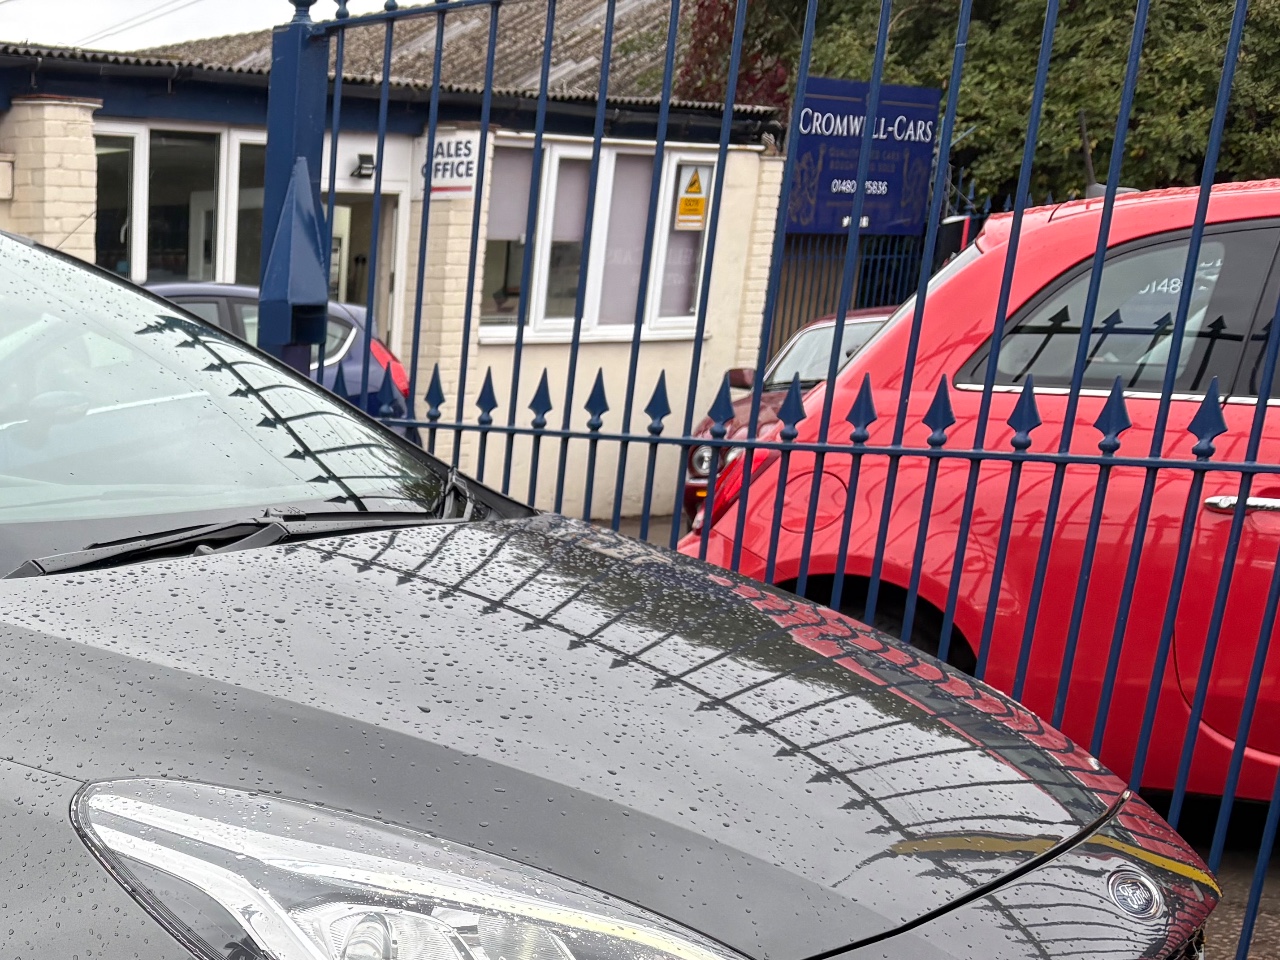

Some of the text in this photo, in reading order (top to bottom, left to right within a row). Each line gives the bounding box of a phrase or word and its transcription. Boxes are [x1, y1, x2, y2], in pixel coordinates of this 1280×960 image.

[799, 108, 933, 143] CROMWLL-CARS
[429, 140, 472, 158] ALES
[865, 181, 888, 195] 5836
[1138, 278, 1183, 294] 148
